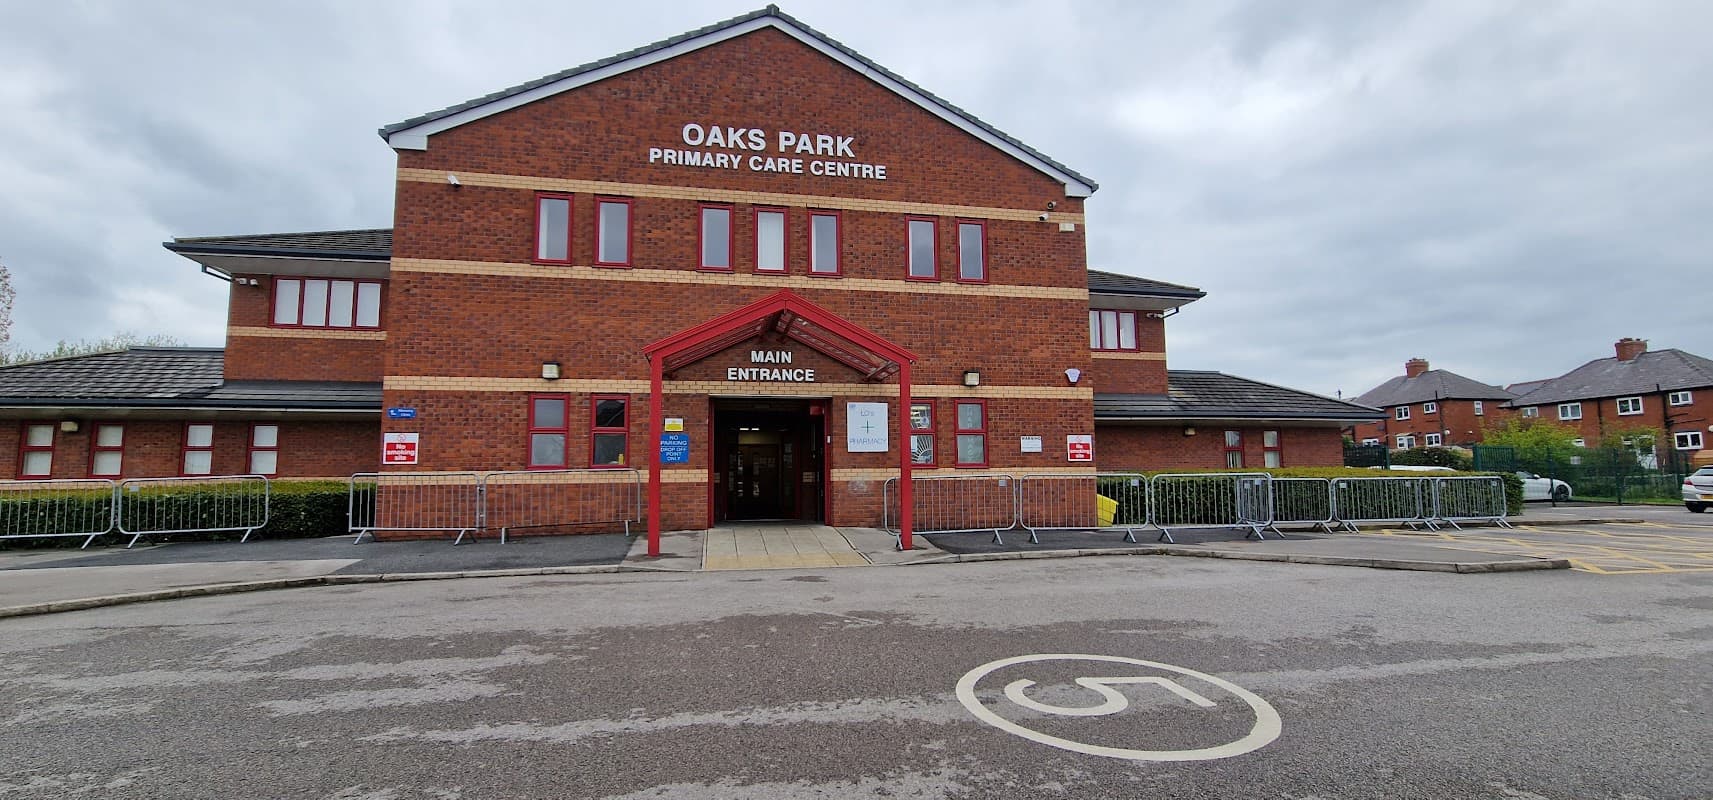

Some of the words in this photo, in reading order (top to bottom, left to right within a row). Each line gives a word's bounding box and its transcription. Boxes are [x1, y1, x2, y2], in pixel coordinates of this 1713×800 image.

[682, 123, 766, 151] OAKS
[779, 131, 855, 158] PARK
[649, 148, 742, 169] PRIMARY
[749, 156, 803, 174] CARE
[809, 160, 887, 180] CENTRE
[751, 350, 792, 363] MAIN
[727, 367, 815, 382] ENTRANCE
[1004, 676, 1217, 716] 5
